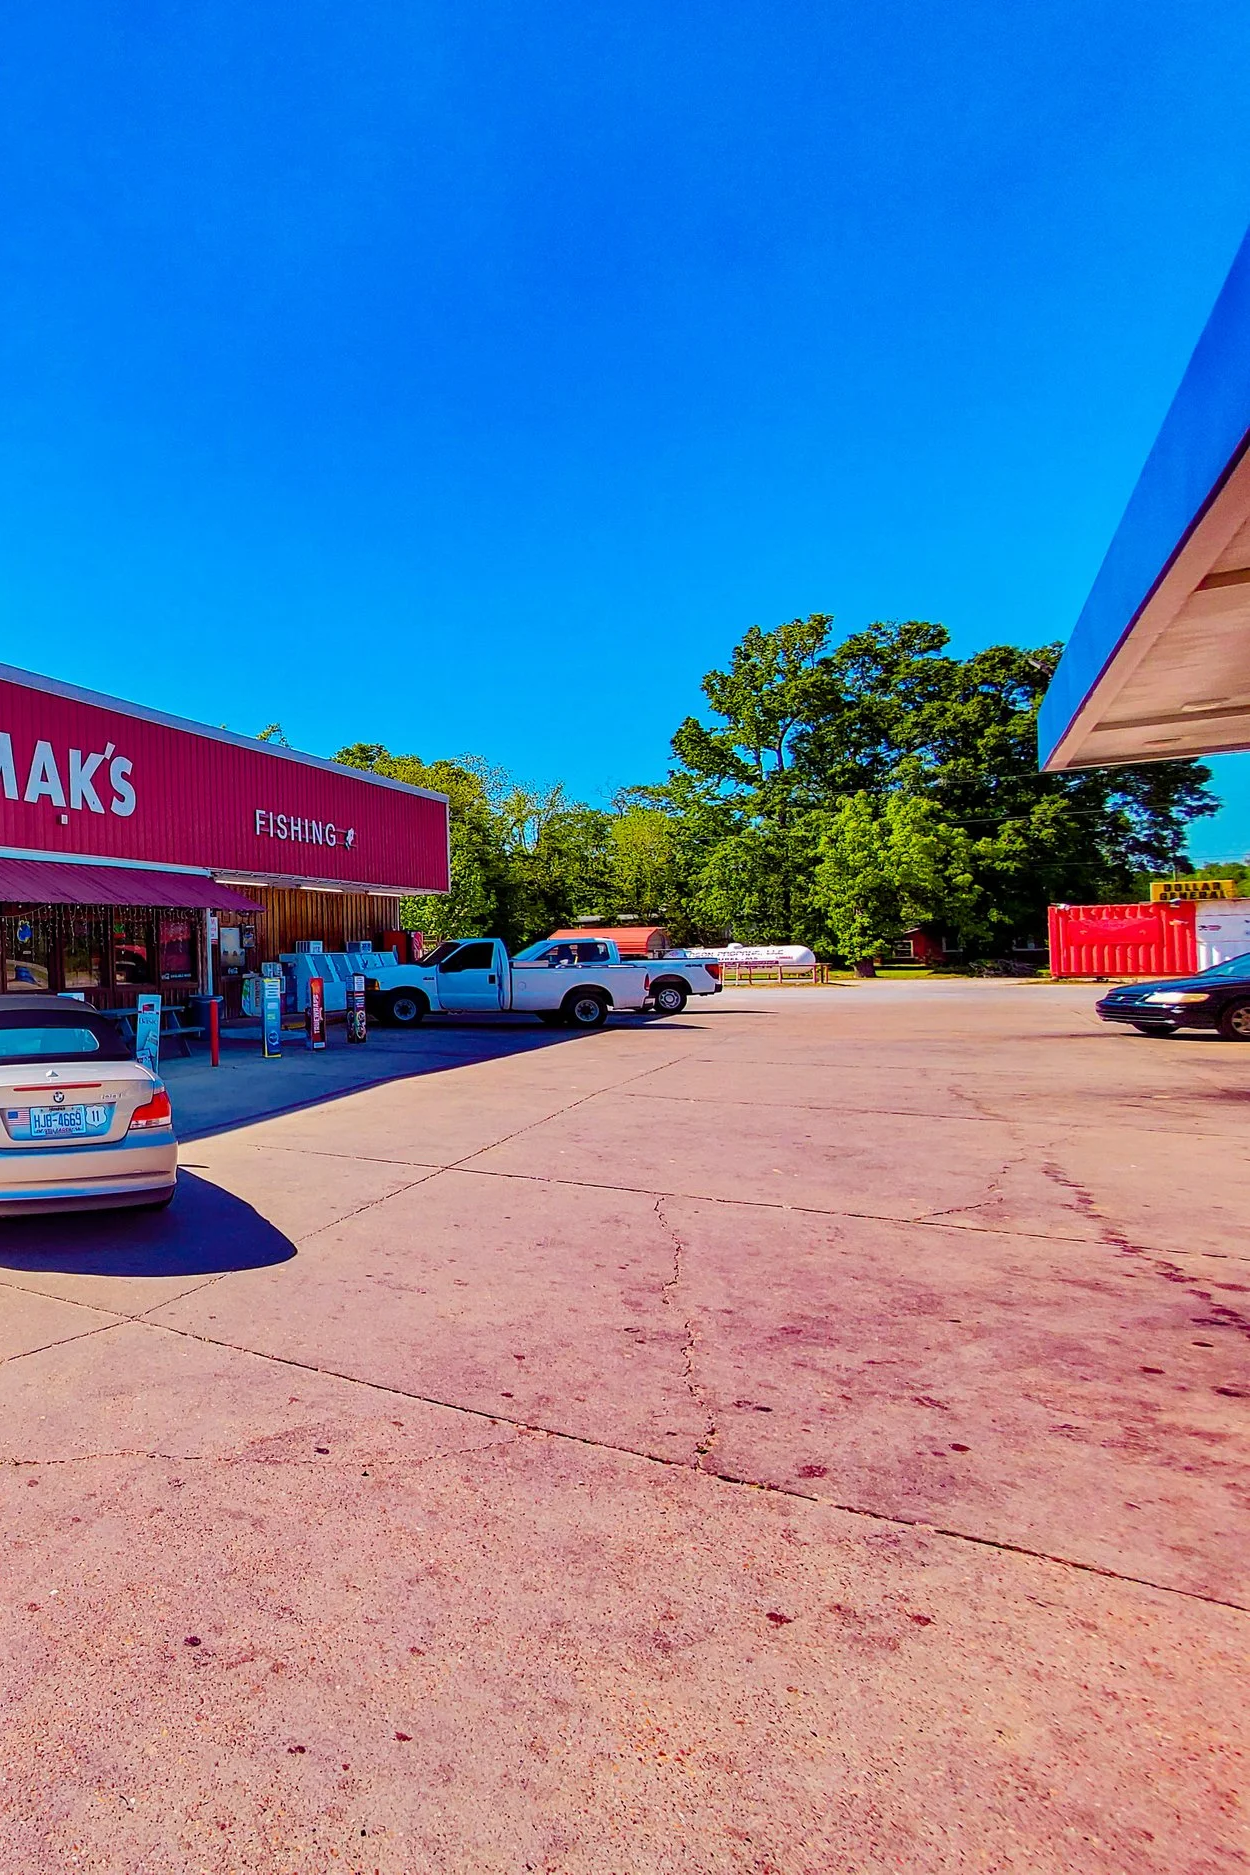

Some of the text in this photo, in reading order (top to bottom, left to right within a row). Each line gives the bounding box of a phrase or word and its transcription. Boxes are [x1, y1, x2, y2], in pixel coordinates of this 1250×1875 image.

[255, 808, 338, 848] FISHING
[1164, 882, 1221, 891] DOLLAR
[1160, 891, 1227, 900] GENERAL
